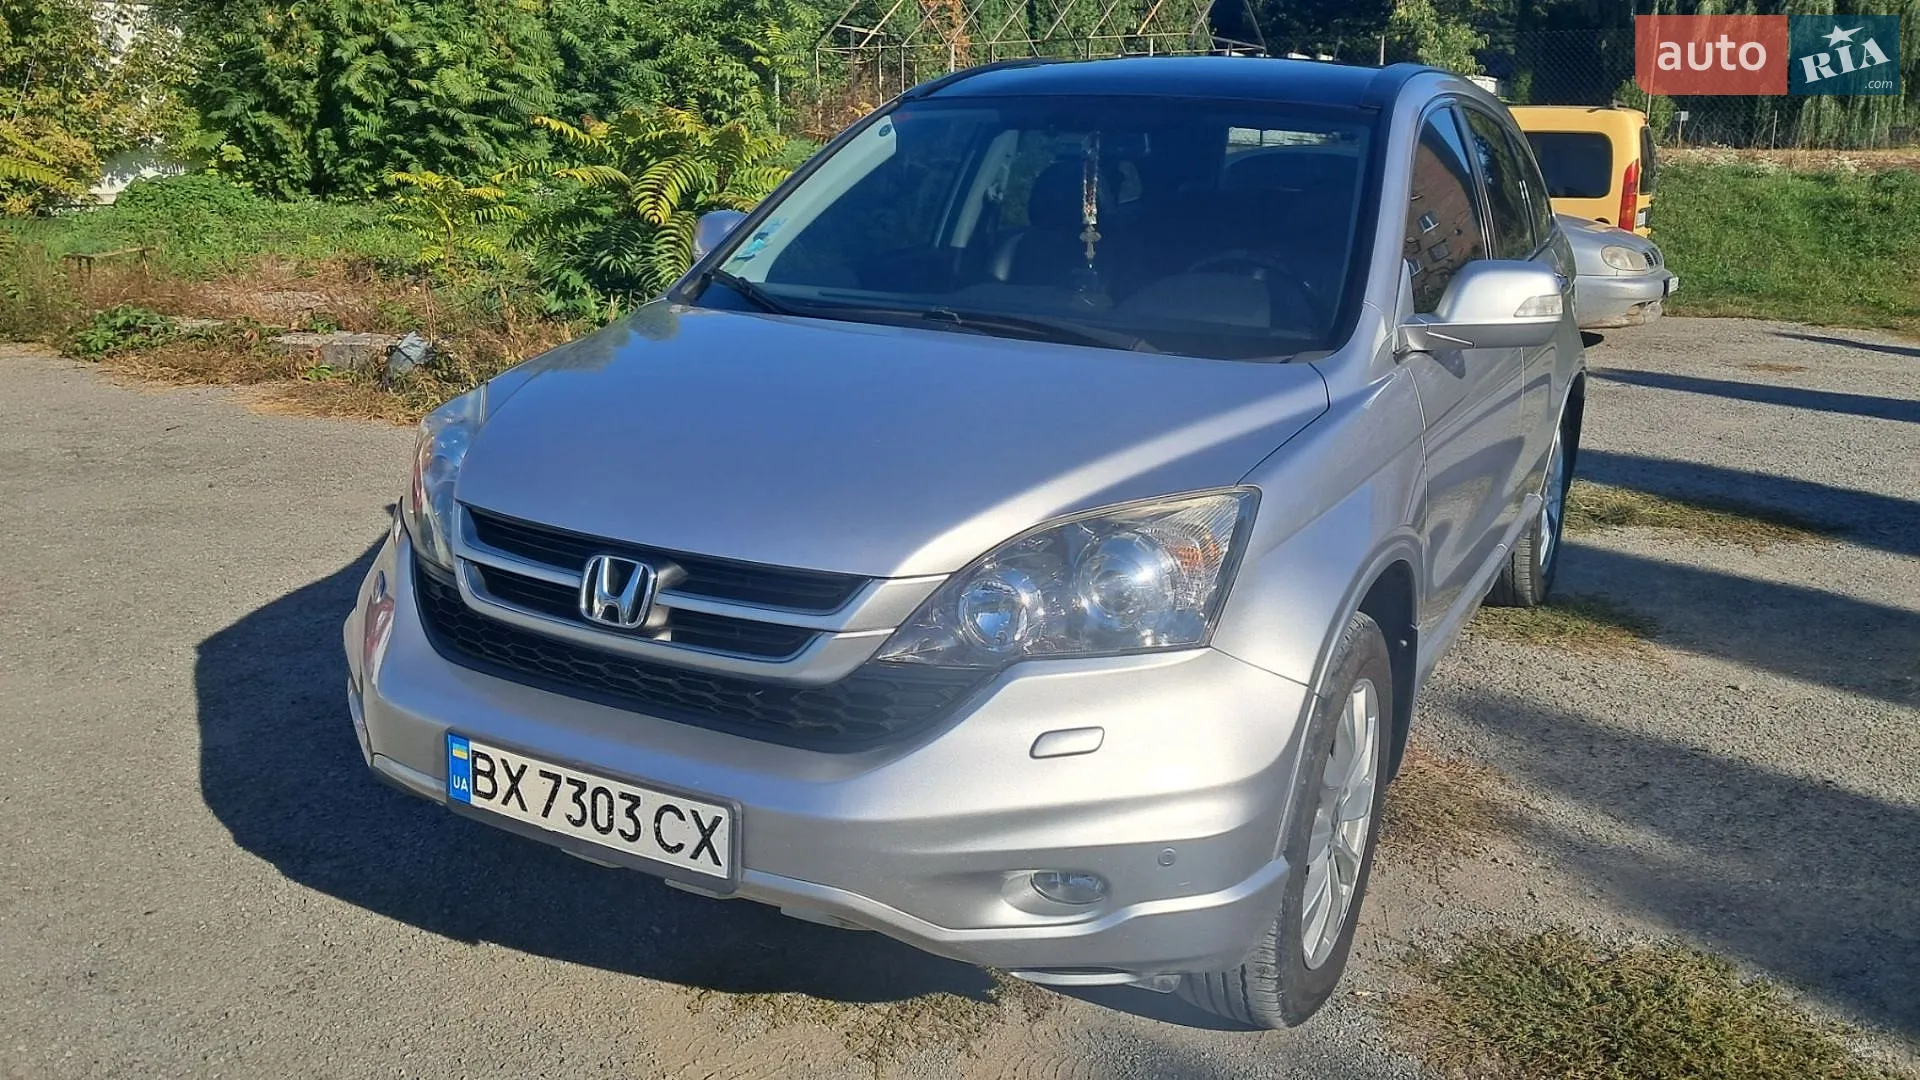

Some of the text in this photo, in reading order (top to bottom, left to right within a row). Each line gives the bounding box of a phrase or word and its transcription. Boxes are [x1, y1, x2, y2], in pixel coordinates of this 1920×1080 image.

[453, 775, 469, 793] UA
[471, 750, 723, 867] BX 7303 CX
